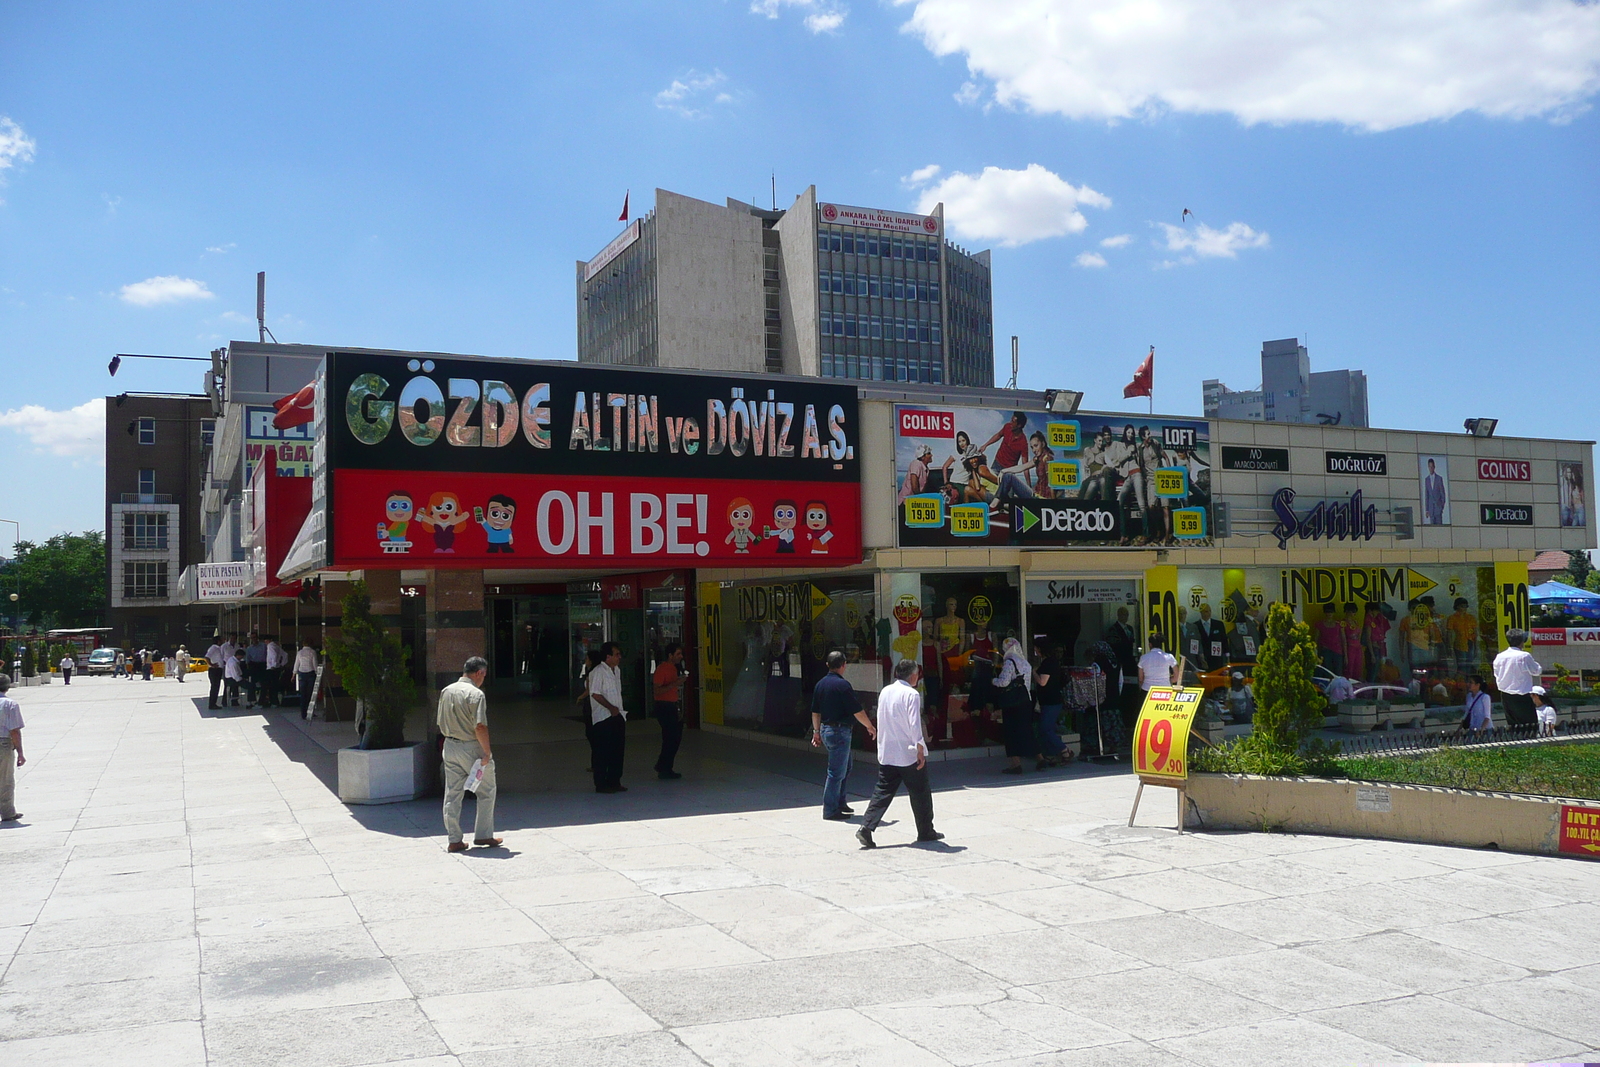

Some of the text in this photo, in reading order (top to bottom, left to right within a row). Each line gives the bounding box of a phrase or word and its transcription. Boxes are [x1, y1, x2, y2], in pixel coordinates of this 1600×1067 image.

[840, 210, 868, 220] ANKARA
[877, 214, 893, 223] ÖZEL
[895, 216, 921, 227] İDARESİ
[860, 220, 881, 228] Genel
[883, 223, 910, 232] Meclisi
[345, 359, 551, 448] GÖZDE
[568, 390, 659, 453] ALTIN
[666, 415, 699, 455] ve
[707, 387, 795, 459] DÖVİZ
[801, 403, 855, 470] A.Ş.
[1053, 433, 1076, 444] 39,99
[1164, 428, 1194, 446] LOFT
[1233, 460, 1256, 469] MARCO
[1330, 456, 1382, 473] DOĞRUÖZ
[1057, 474, 1077, 484] 14,99
[1160, 480, 1181, 490] 29,99
[911, 509, 936, 521] 19,90
[1041, 507, 1114, 532] DeFacto
[1271, 487, 1376, 550] Şanlı
[1495, 508, 1528, 521] DeFacto
[536, 489, 709, 557] OH BE!
[958, 519, 980, 530] 19,90
[1181, 520, 1198, 531] 9,99
[200, 565, 220, 578] BÜYÜK
[1047, 580, 1084, 603] Şanlı
[1281, 567, 1405, 604] İNDİRİM
[1448, 583, 1456, 596] 9
[738, 582, 812, 621] İNDİRİM
[1191, 594, 1201, 608] 39
[1251, 594, 1263, 607] 59
[1534, 632, 1564, 641] MERKEZ
[1573, 631, 1600, 642] KA
[1174, 692, 1197, 702] LOFT
[1154, 703, 1184, 712] KOTLAR
[1566, 826, 1590, 840] 100.YIL
